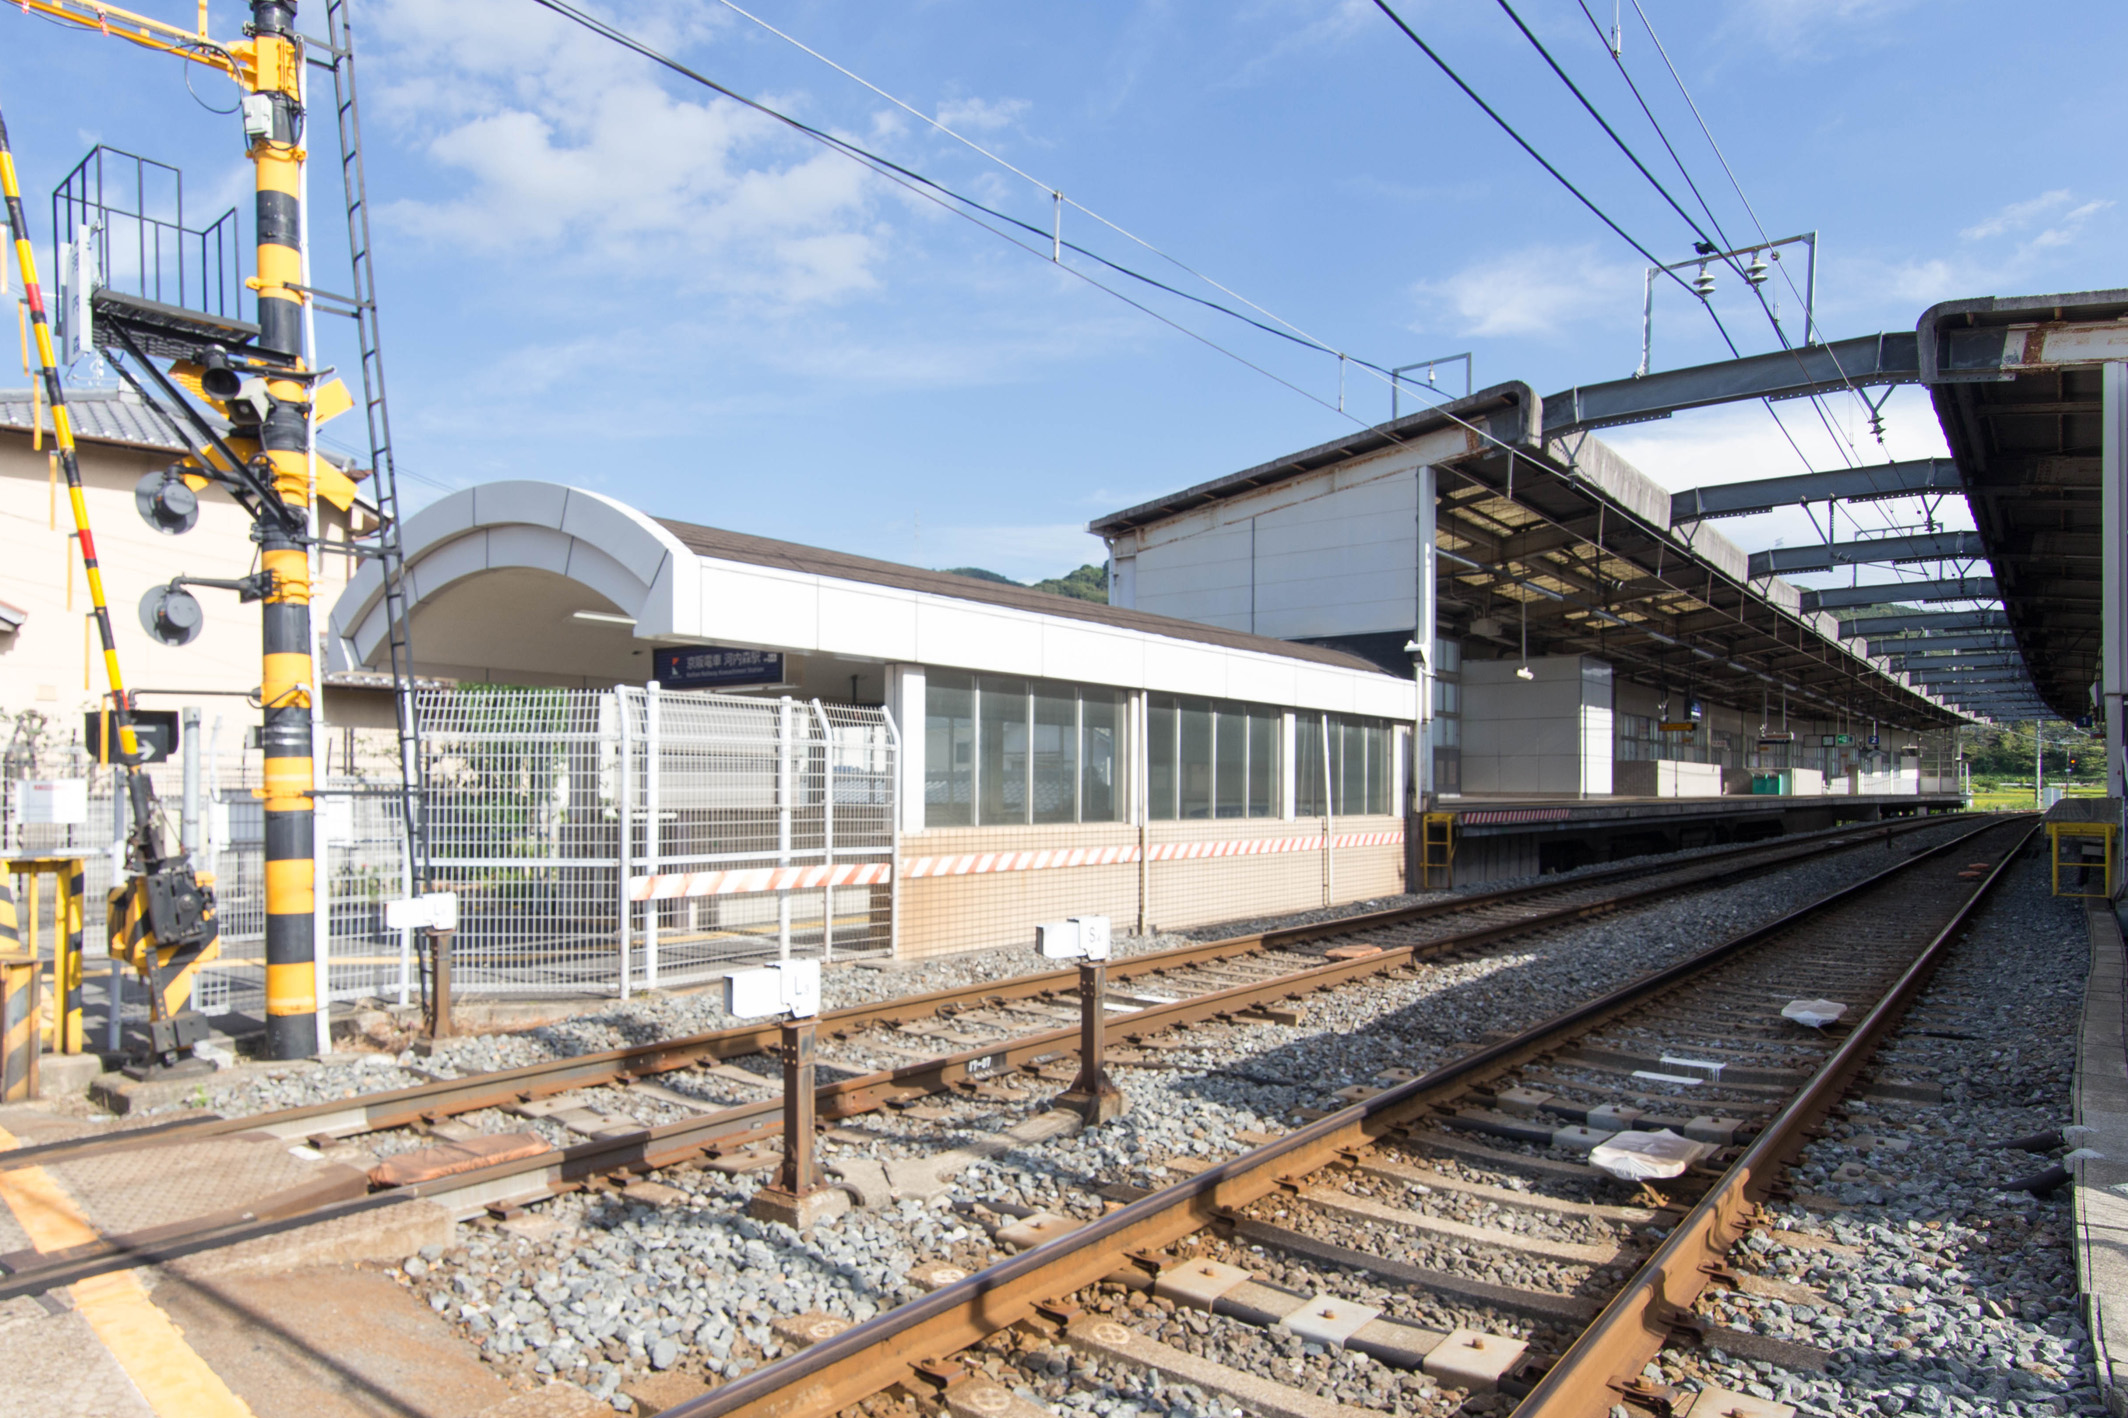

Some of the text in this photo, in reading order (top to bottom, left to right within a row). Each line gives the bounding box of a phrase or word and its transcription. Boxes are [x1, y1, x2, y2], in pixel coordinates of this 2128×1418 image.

[686, 651, 761, 670] 京阪電車 河内森駅
